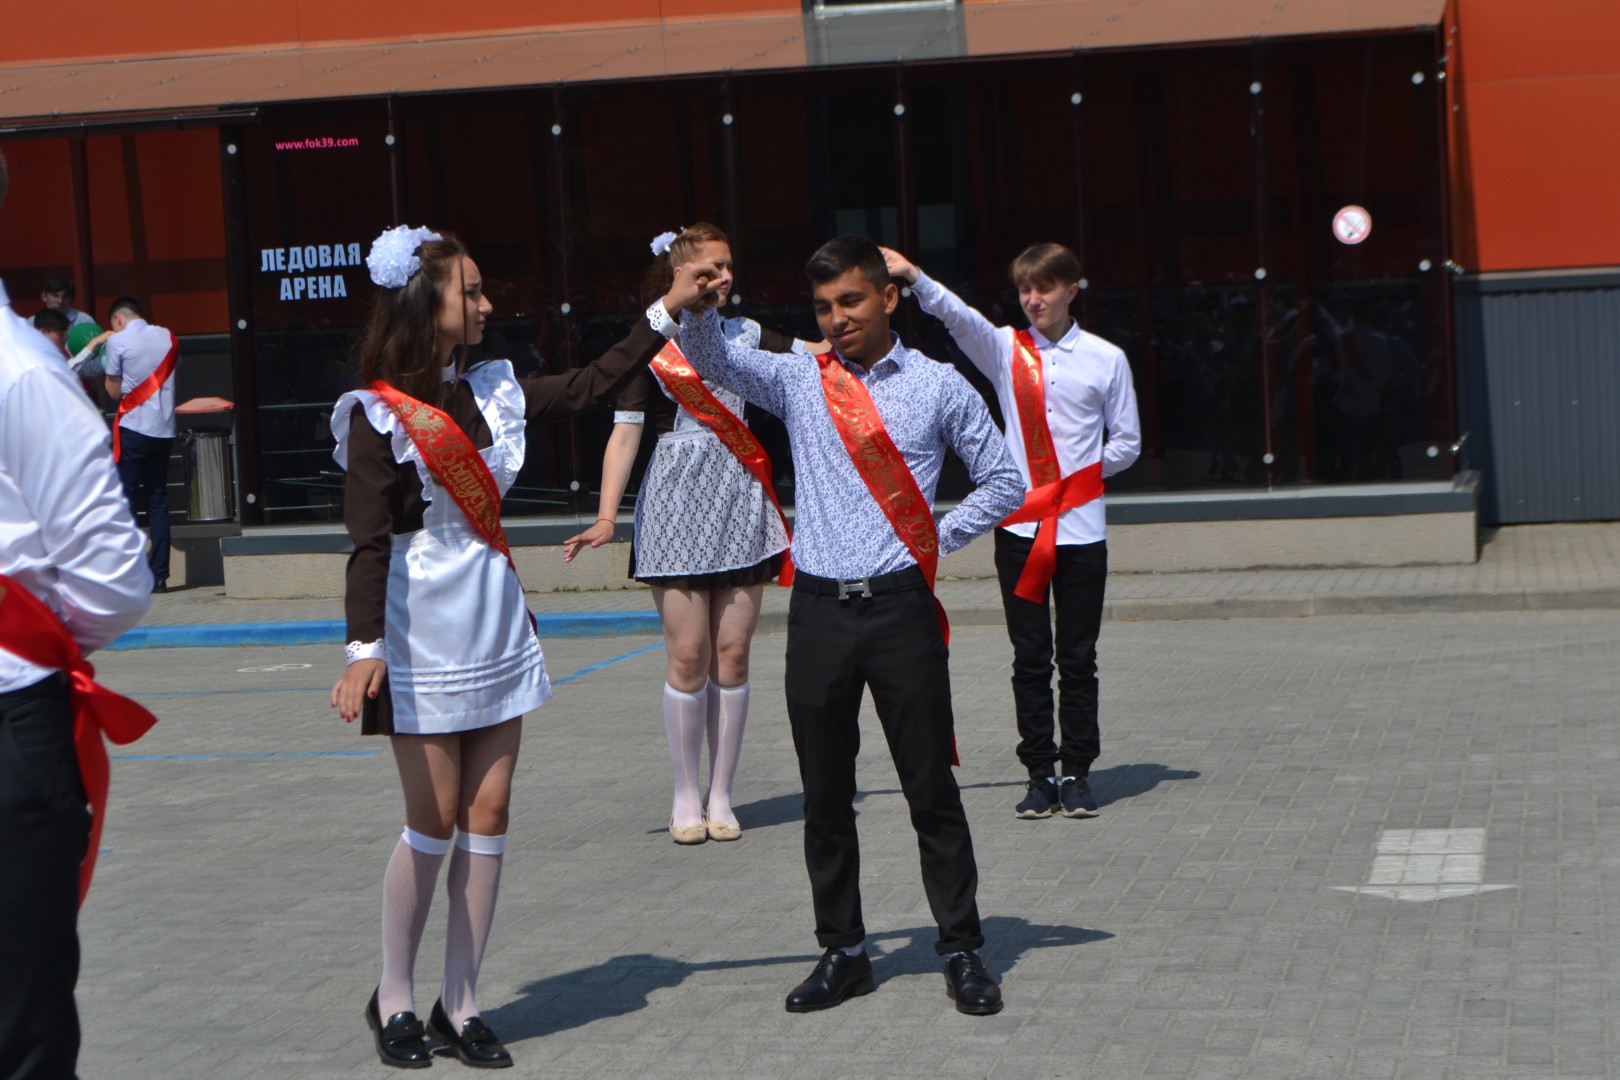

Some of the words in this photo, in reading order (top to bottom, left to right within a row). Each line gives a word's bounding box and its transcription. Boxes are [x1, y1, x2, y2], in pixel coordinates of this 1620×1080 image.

[275, 137, 359, 151] www.fok39.com
[260, 242, 362, 274] ЛЕДОВАЯ
[279, 274, 348, 301] АРЕНА
[900, 509, 936, 554] 2019
